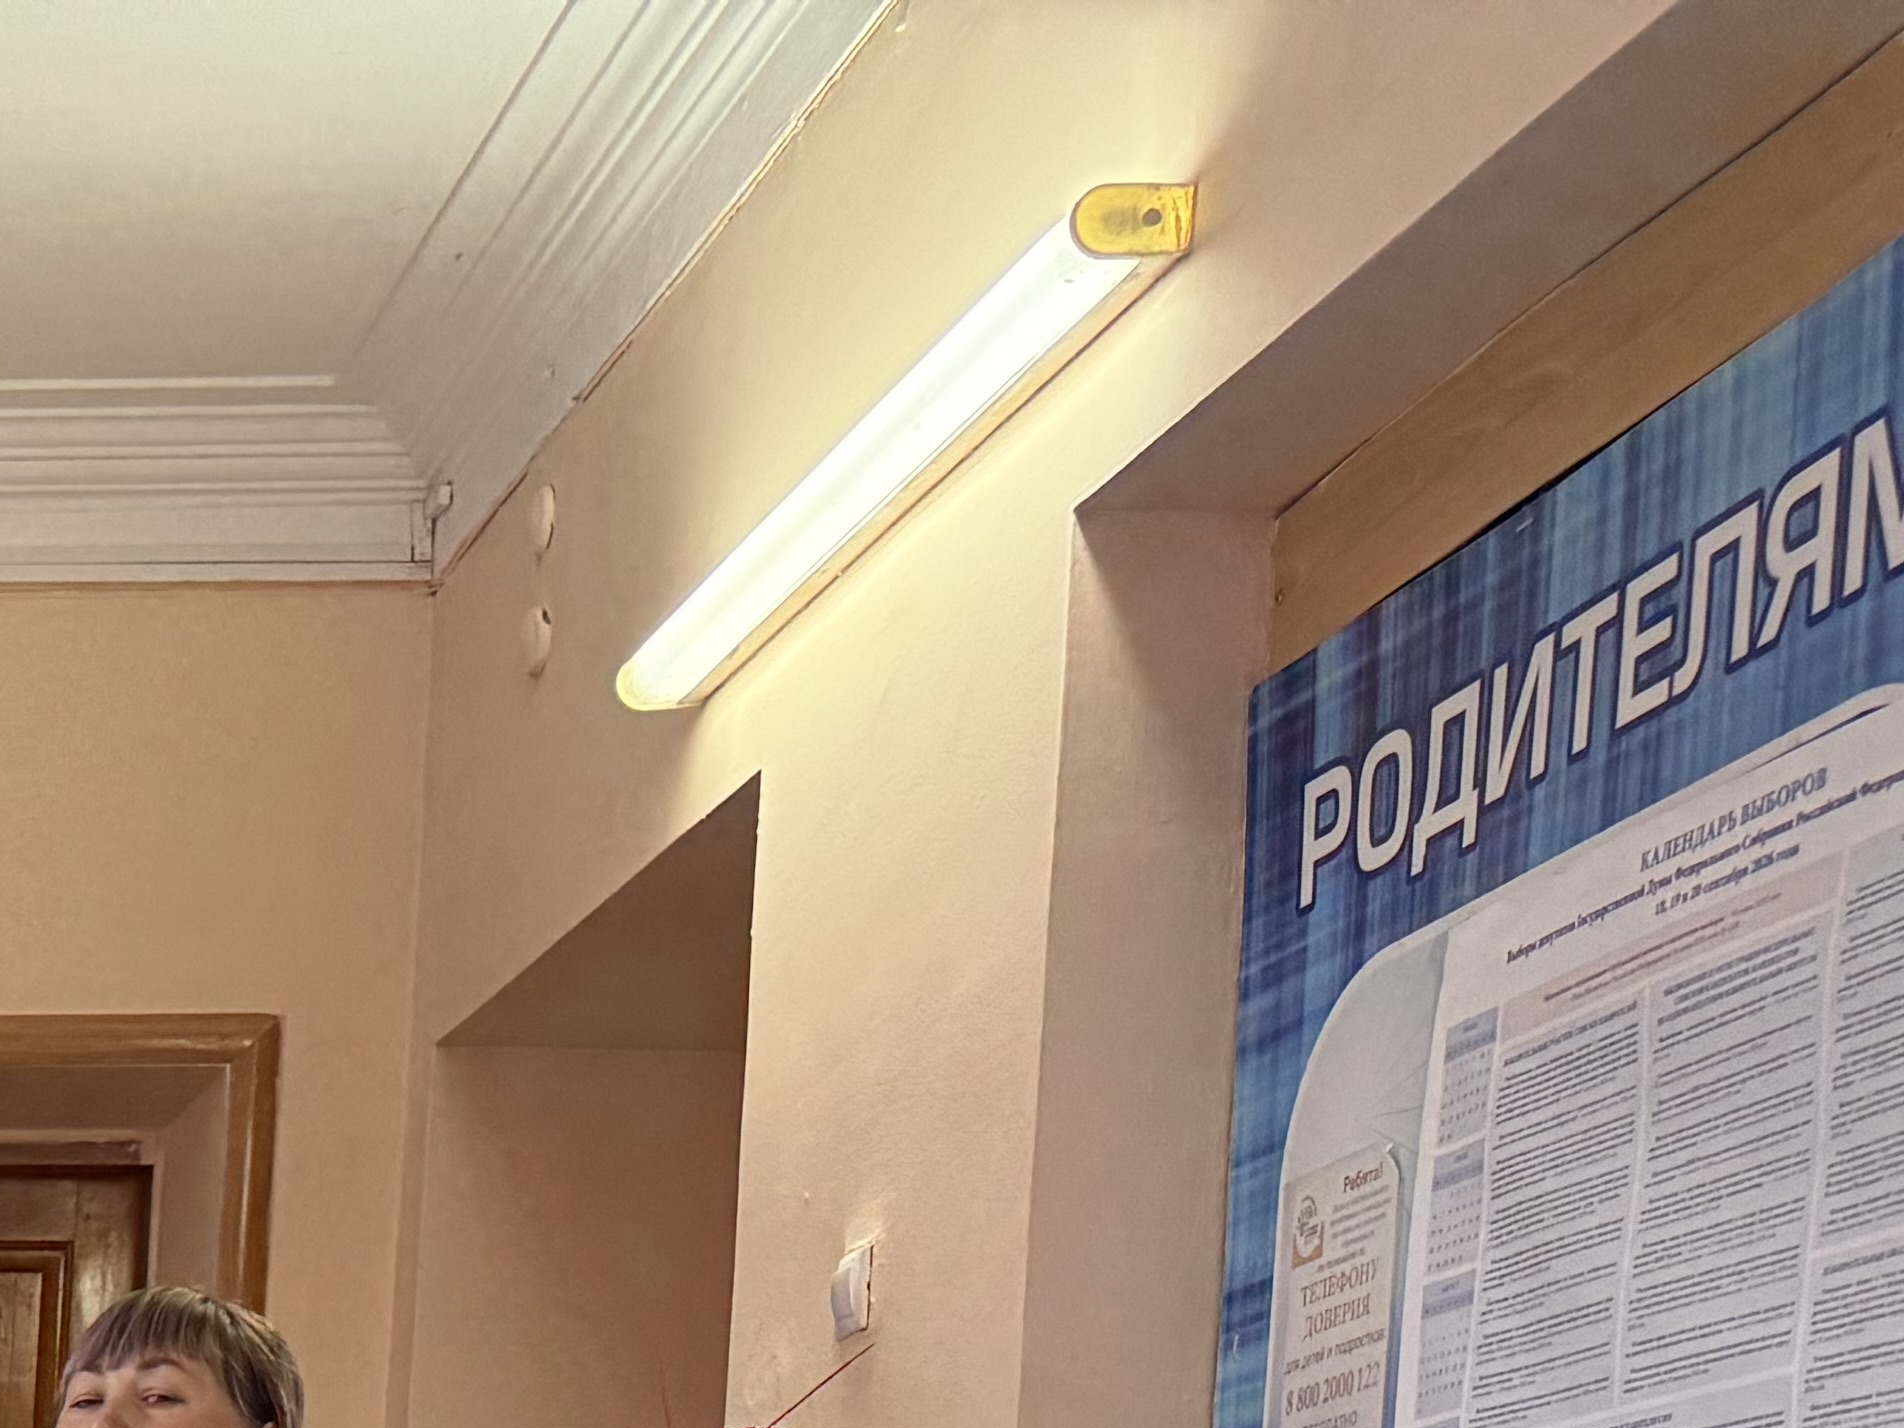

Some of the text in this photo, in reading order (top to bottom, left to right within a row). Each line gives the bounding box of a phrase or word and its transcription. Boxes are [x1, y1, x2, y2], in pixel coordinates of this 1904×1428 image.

[1640, 767, 1828, 872] КАЛЕНДАРЬ ВЫБОРОВ
[1301, 1257, 1379, 1308] ТЕЛЕФОНУ
[1302, 1293, 1371, 1343] ДОВЕРИЯ
